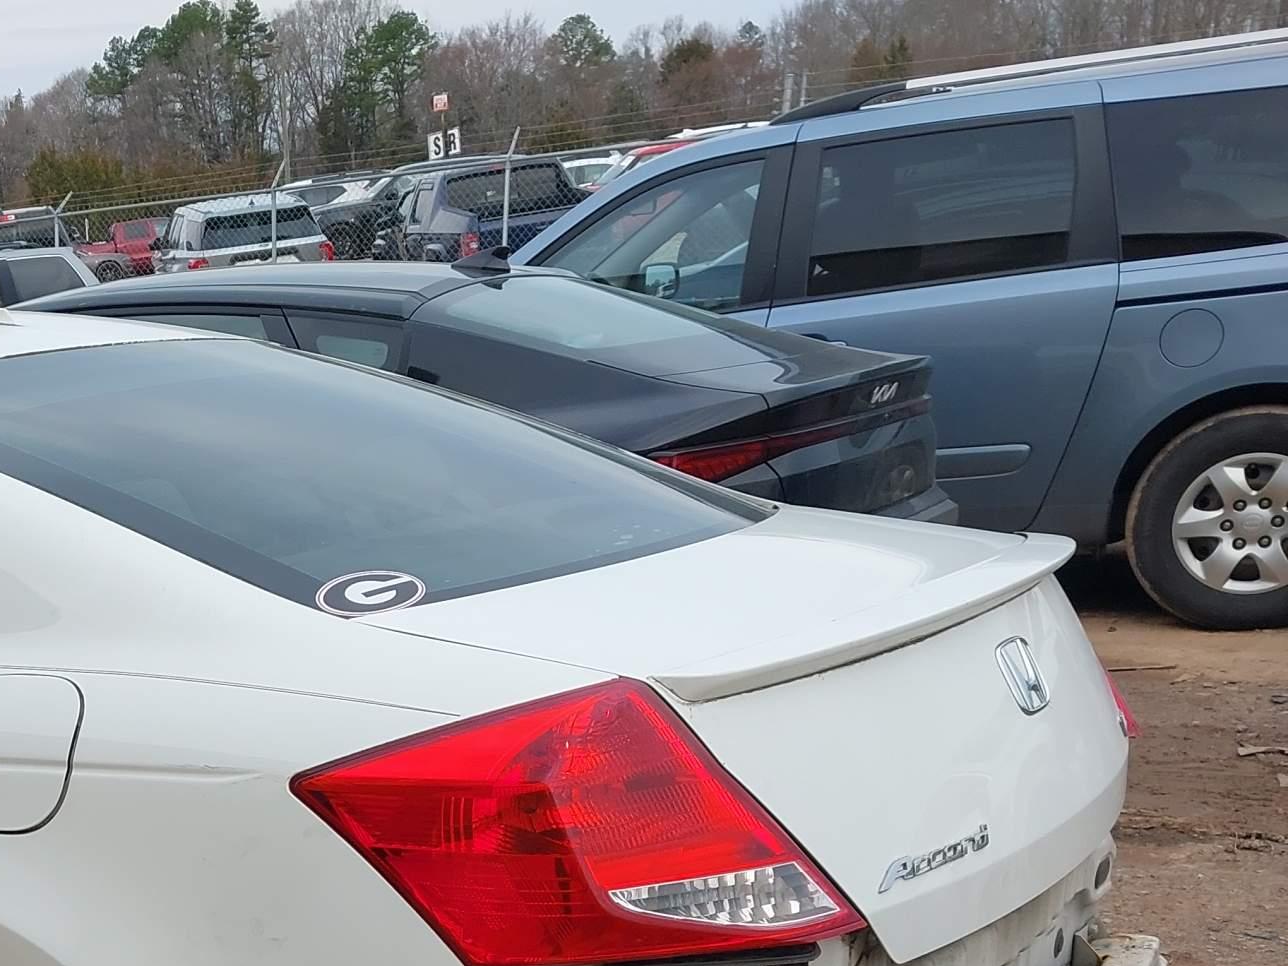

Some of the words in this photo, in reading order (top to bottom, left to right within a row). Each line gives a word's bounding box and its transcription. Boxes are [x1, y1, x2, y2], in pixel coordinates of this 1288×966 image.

[433, 136, 441, 156] S
[871, 382, 899, 404] KIA
[878, 823, 990, 894] Accord
